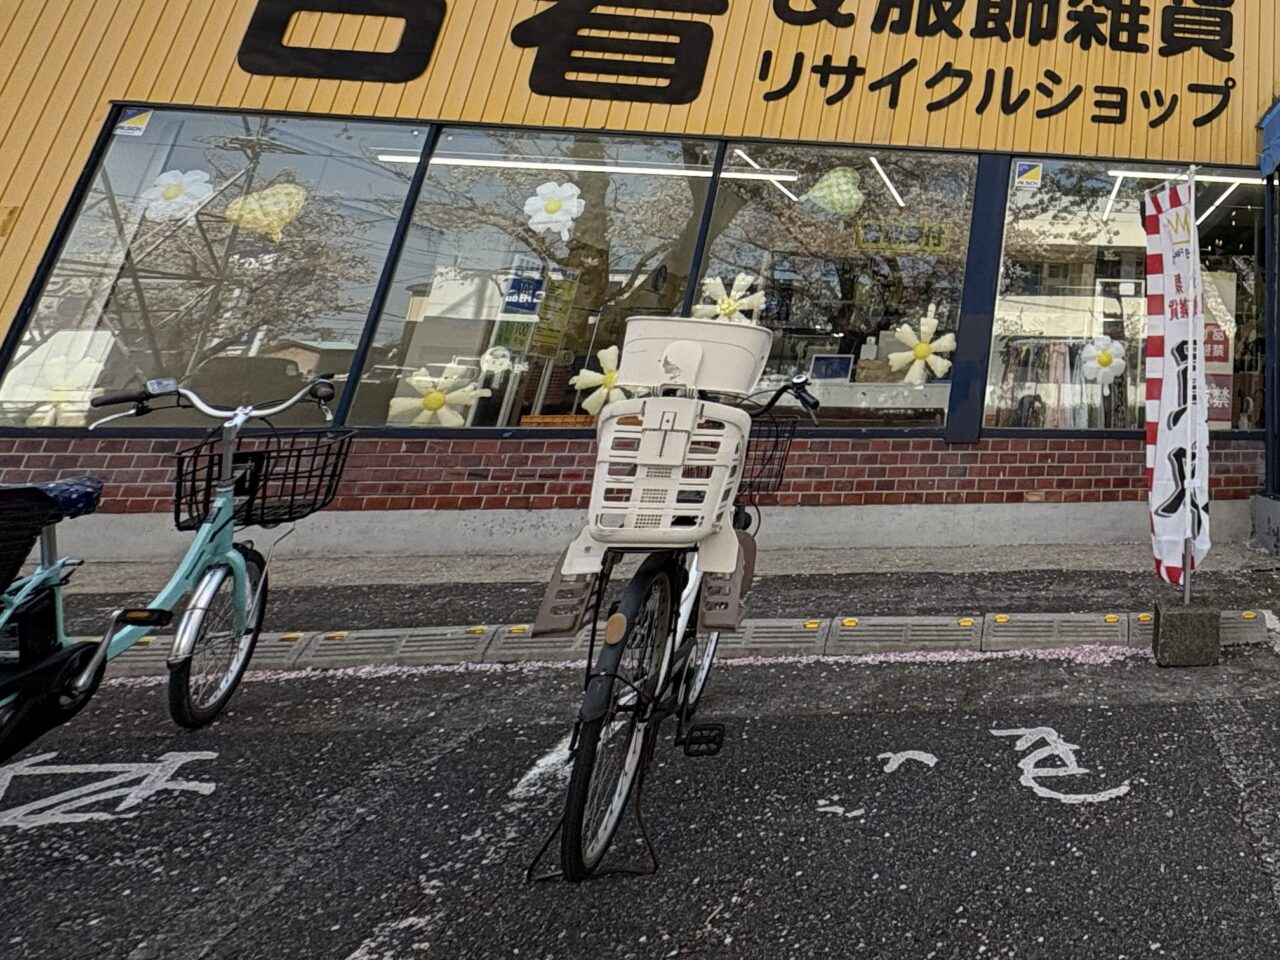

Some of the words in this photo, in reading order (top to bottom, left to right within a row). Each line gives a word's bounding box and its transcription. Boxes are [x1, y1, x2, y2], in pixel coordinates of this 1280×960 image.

[758, 49, 1237, 129] リサイクルショップ
